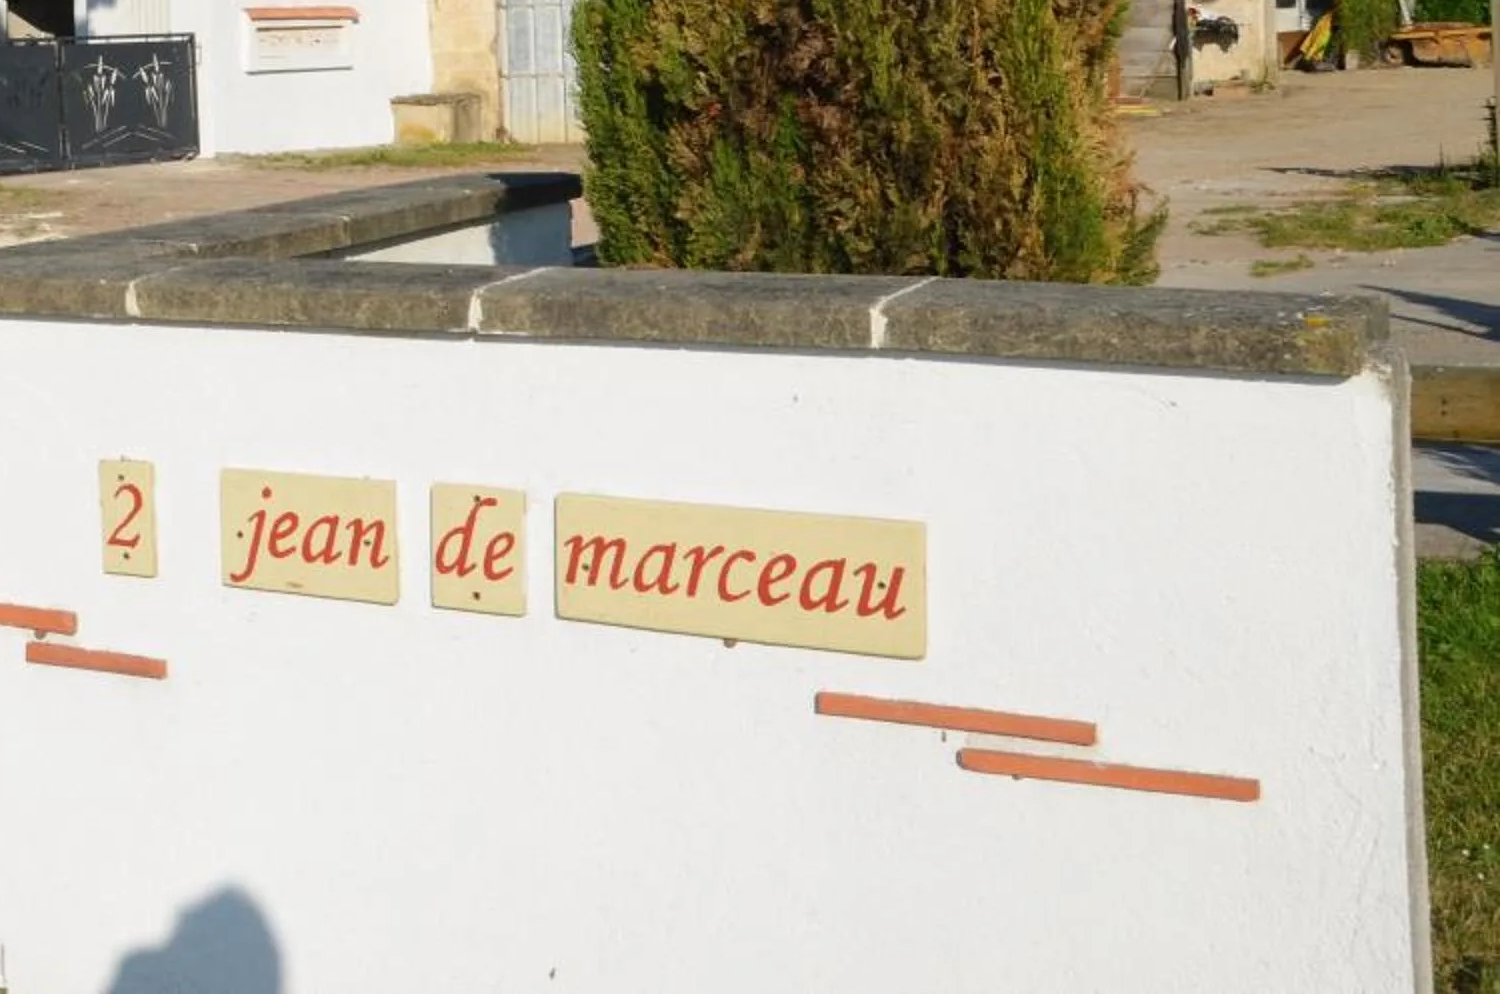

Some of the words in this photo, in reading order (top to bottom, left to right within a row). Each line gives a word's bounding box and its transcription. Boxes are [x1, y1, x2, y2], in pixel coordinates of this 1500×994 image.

[106, 482, 144, 550] 2
[229, 485, 390, 584] jean
[434, 496, 517, 583] de
[564, 532, 908, 622] marceau
